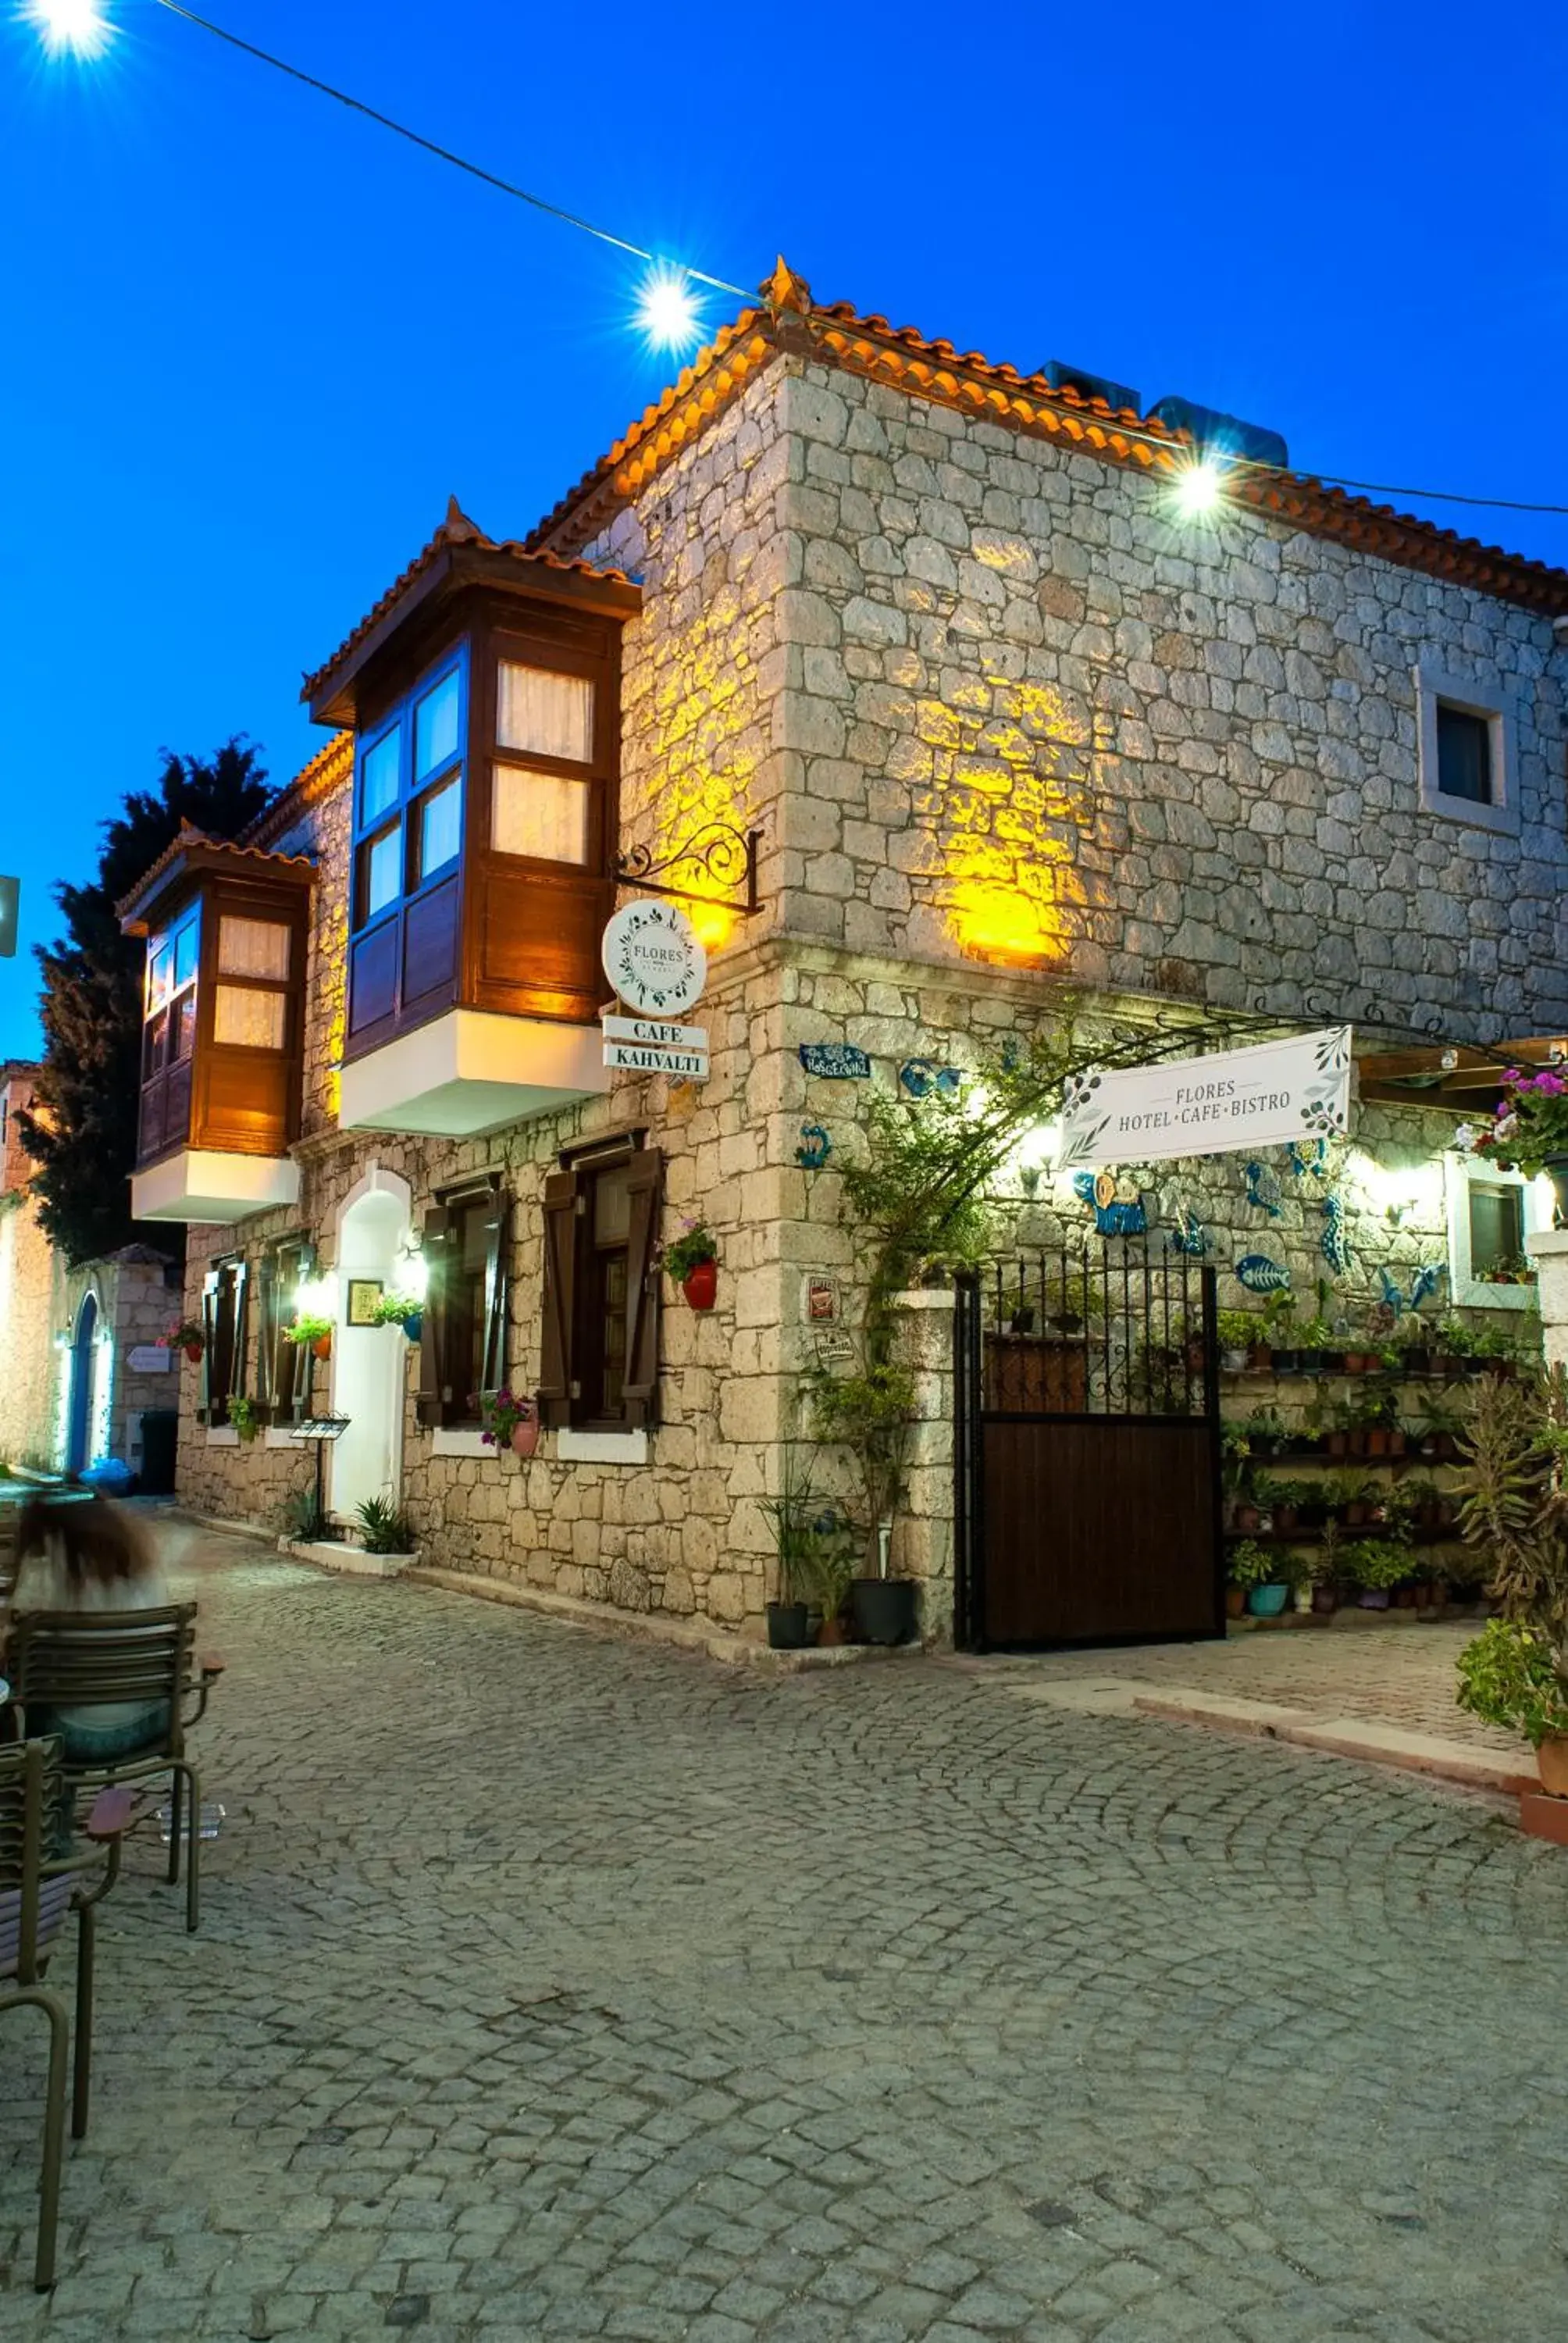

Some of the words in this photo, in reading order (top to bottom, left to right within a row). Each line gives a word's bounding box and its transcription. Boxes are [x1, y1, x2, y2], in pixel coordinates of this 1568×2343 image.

[633, 945, 683, 962] FLORES
[633, 1022, 683, 1043] CAFE
[616, 1049, 700, 1072] KAHVALTI
[1176, 1080, 1235, 1104] FLORES
[1119, 1111, 1171, 1132] HOTEL
[1181, 1106, 1221, 1125] CAFE
[1231, 1091, 1291, 1117] BISTRO
